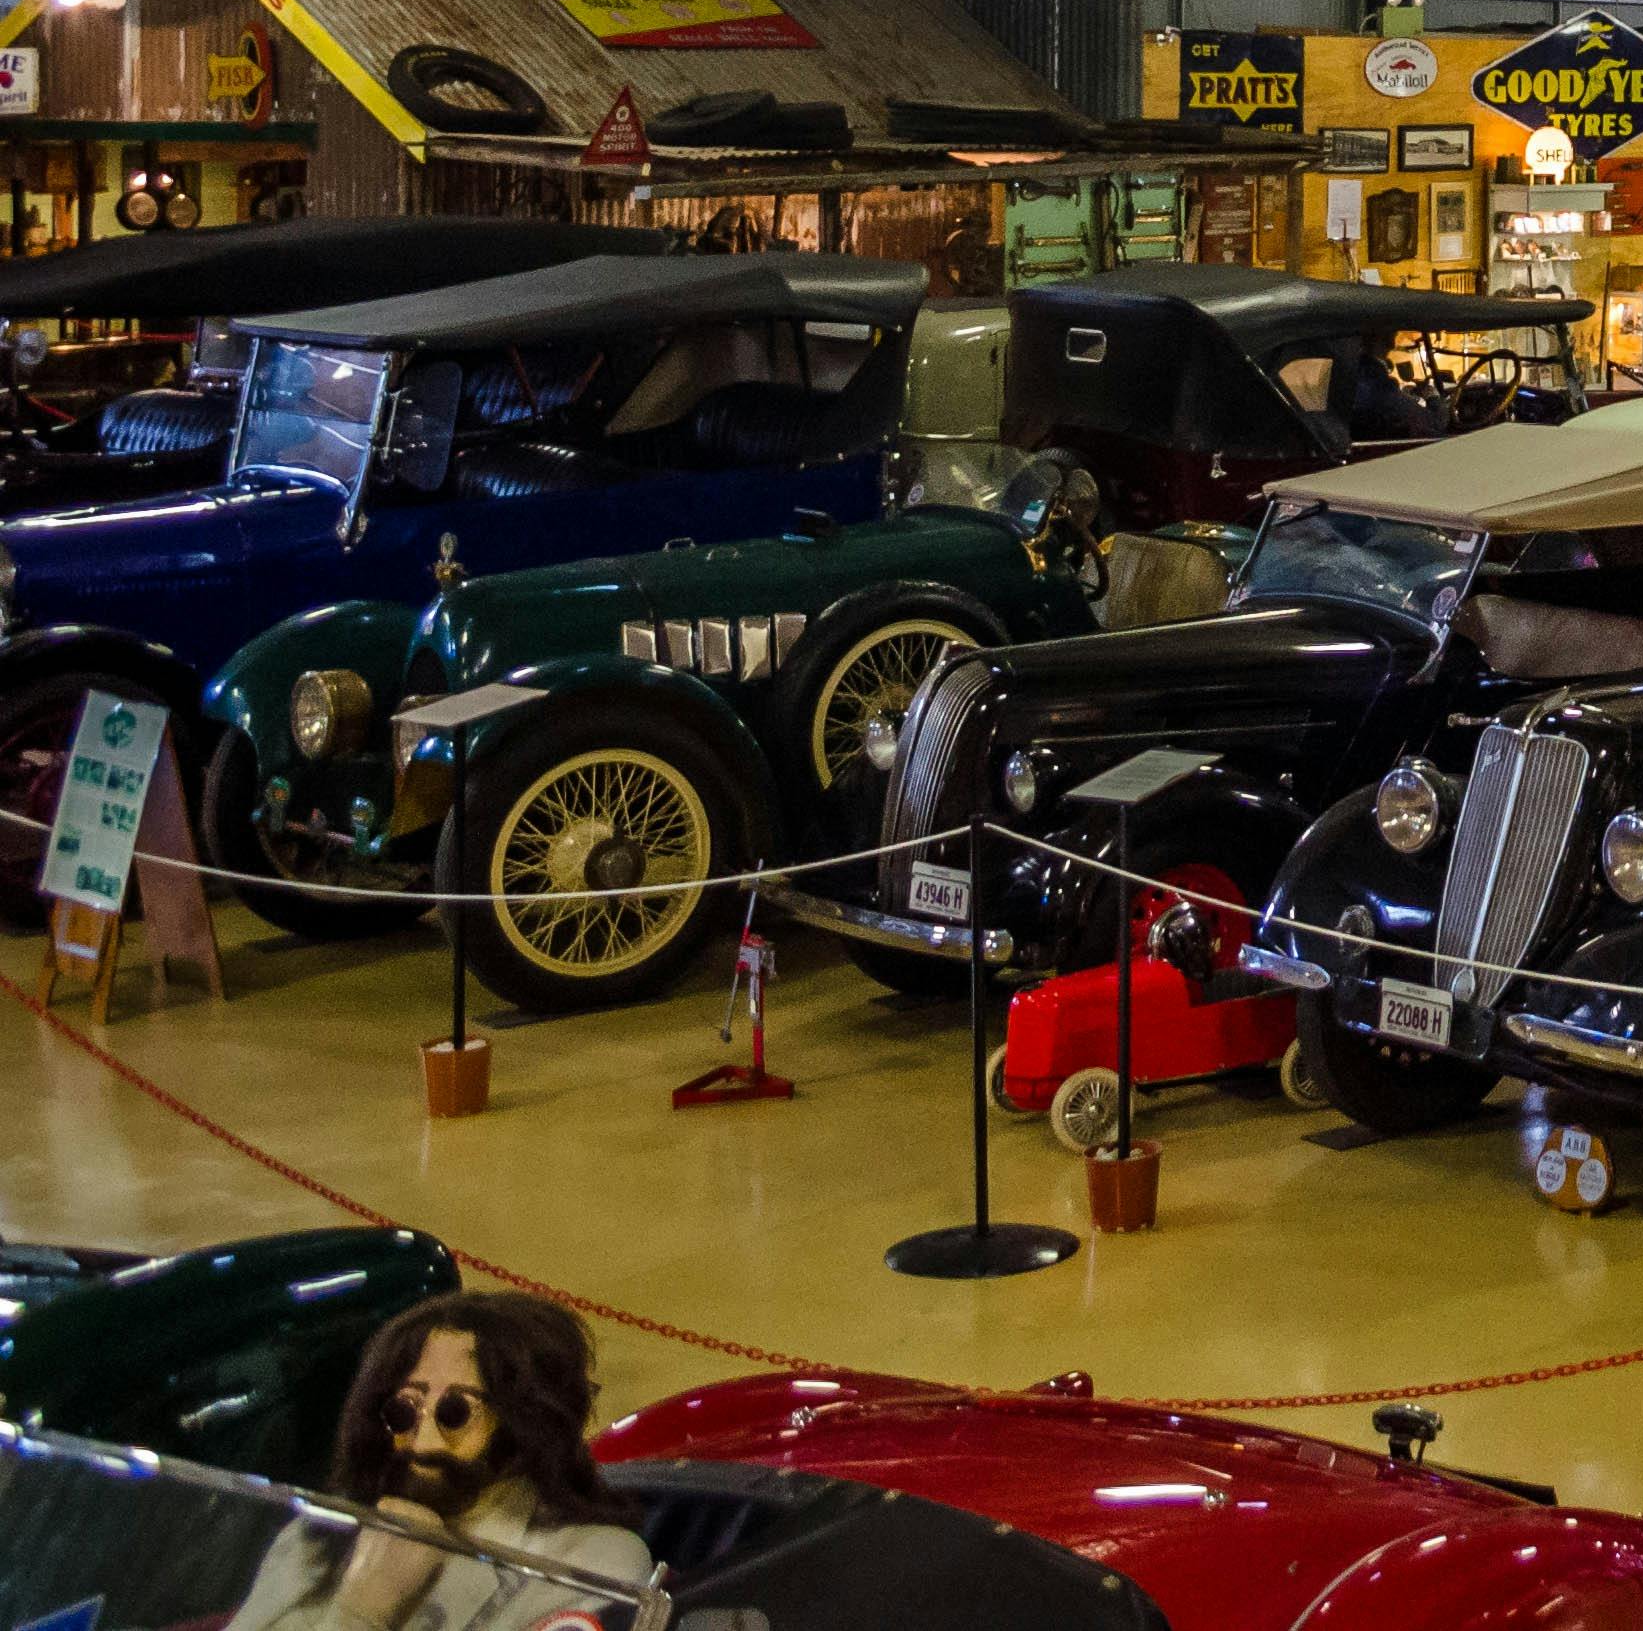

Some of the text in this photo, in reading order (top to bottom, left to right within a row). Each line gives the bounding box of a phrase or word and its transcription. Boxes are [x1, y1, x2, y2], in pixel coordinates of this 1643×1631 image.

[1191, 43, 1221, 57] GET
[1199, 75, 1291, 105] PRATT'S
[1549, 113, 1633, 137] TYRES
[599, 141, 636, 153] SPIRIT
[1535, 148, 1573, 163] SHELL
[915, 880, 963, 909] 43946 H
[1432, 1013, 1443, 1036] H
